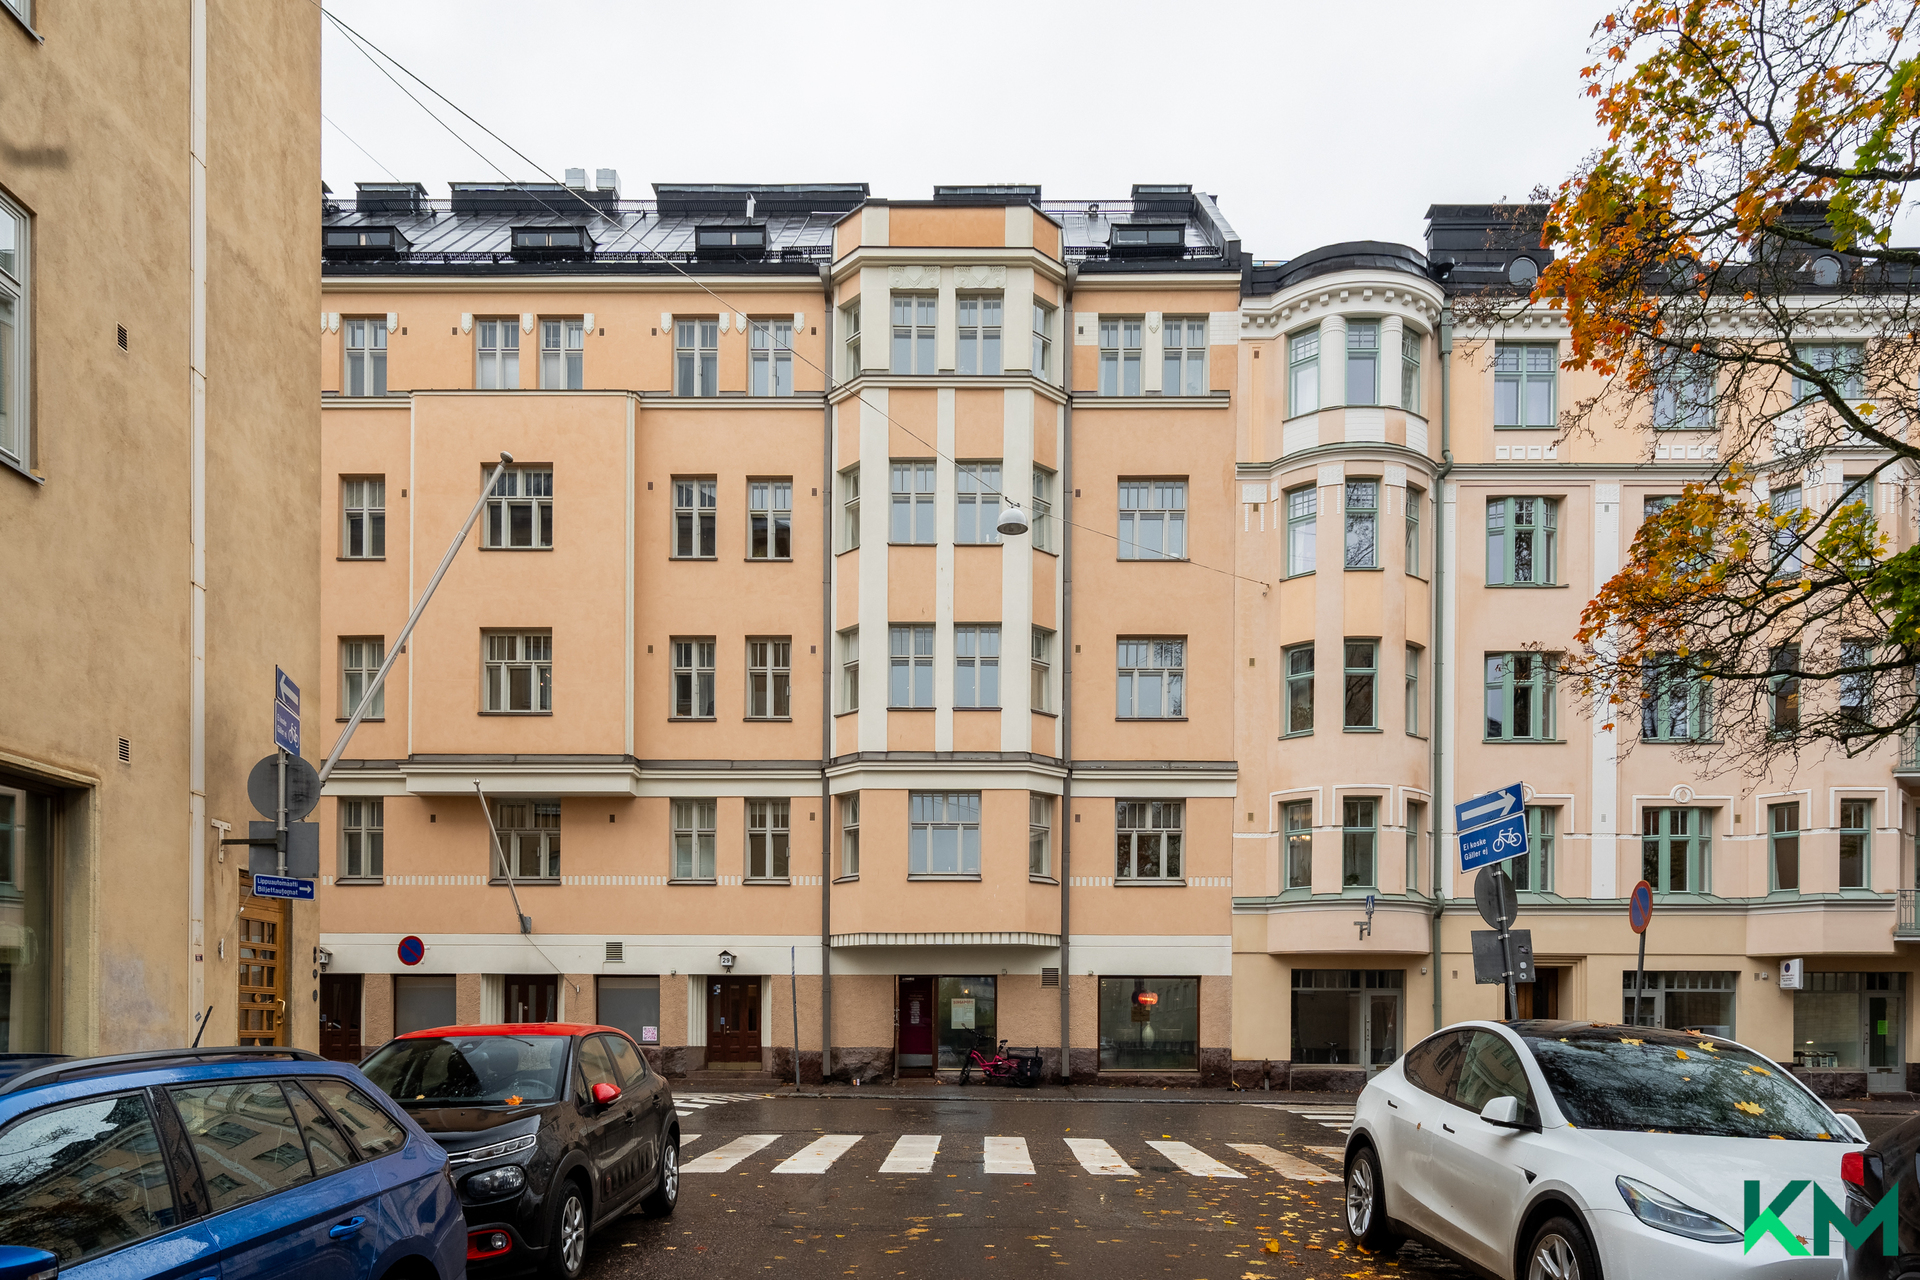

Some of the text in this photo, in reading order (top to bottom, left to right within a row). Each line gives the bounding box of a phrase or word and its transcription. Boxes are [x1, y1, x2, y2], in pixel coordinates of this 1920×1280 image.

[1463, 839, 1486, 851] Ei koske
[1464, 847, 1488, 860] Gäller ej
[257, 877, 299, 887] Lippuautomaatti
[257, 886, 299, 896] Biljettautomat
